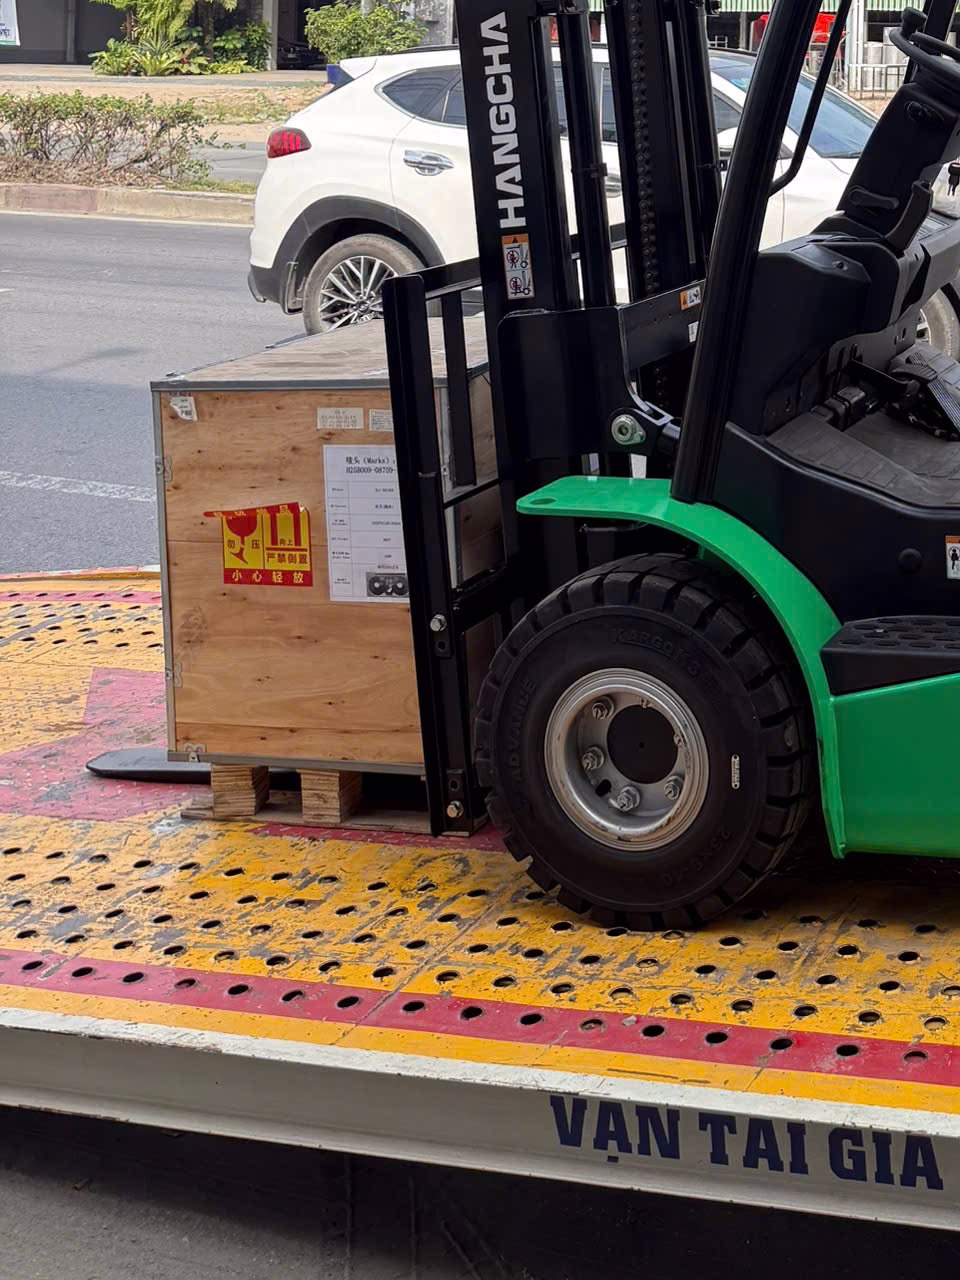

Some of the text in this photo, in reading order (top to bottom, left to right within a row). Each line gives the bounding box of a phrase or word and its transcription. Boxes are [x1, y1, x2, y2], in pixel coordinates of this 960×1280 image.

[480, 11, 527, 229] HANGCHA
[232, 569, 304, 584] 小心轻放
[550, 1095, 680, 1163] VẠN
[829, 1127, 943, 1190] GIA
